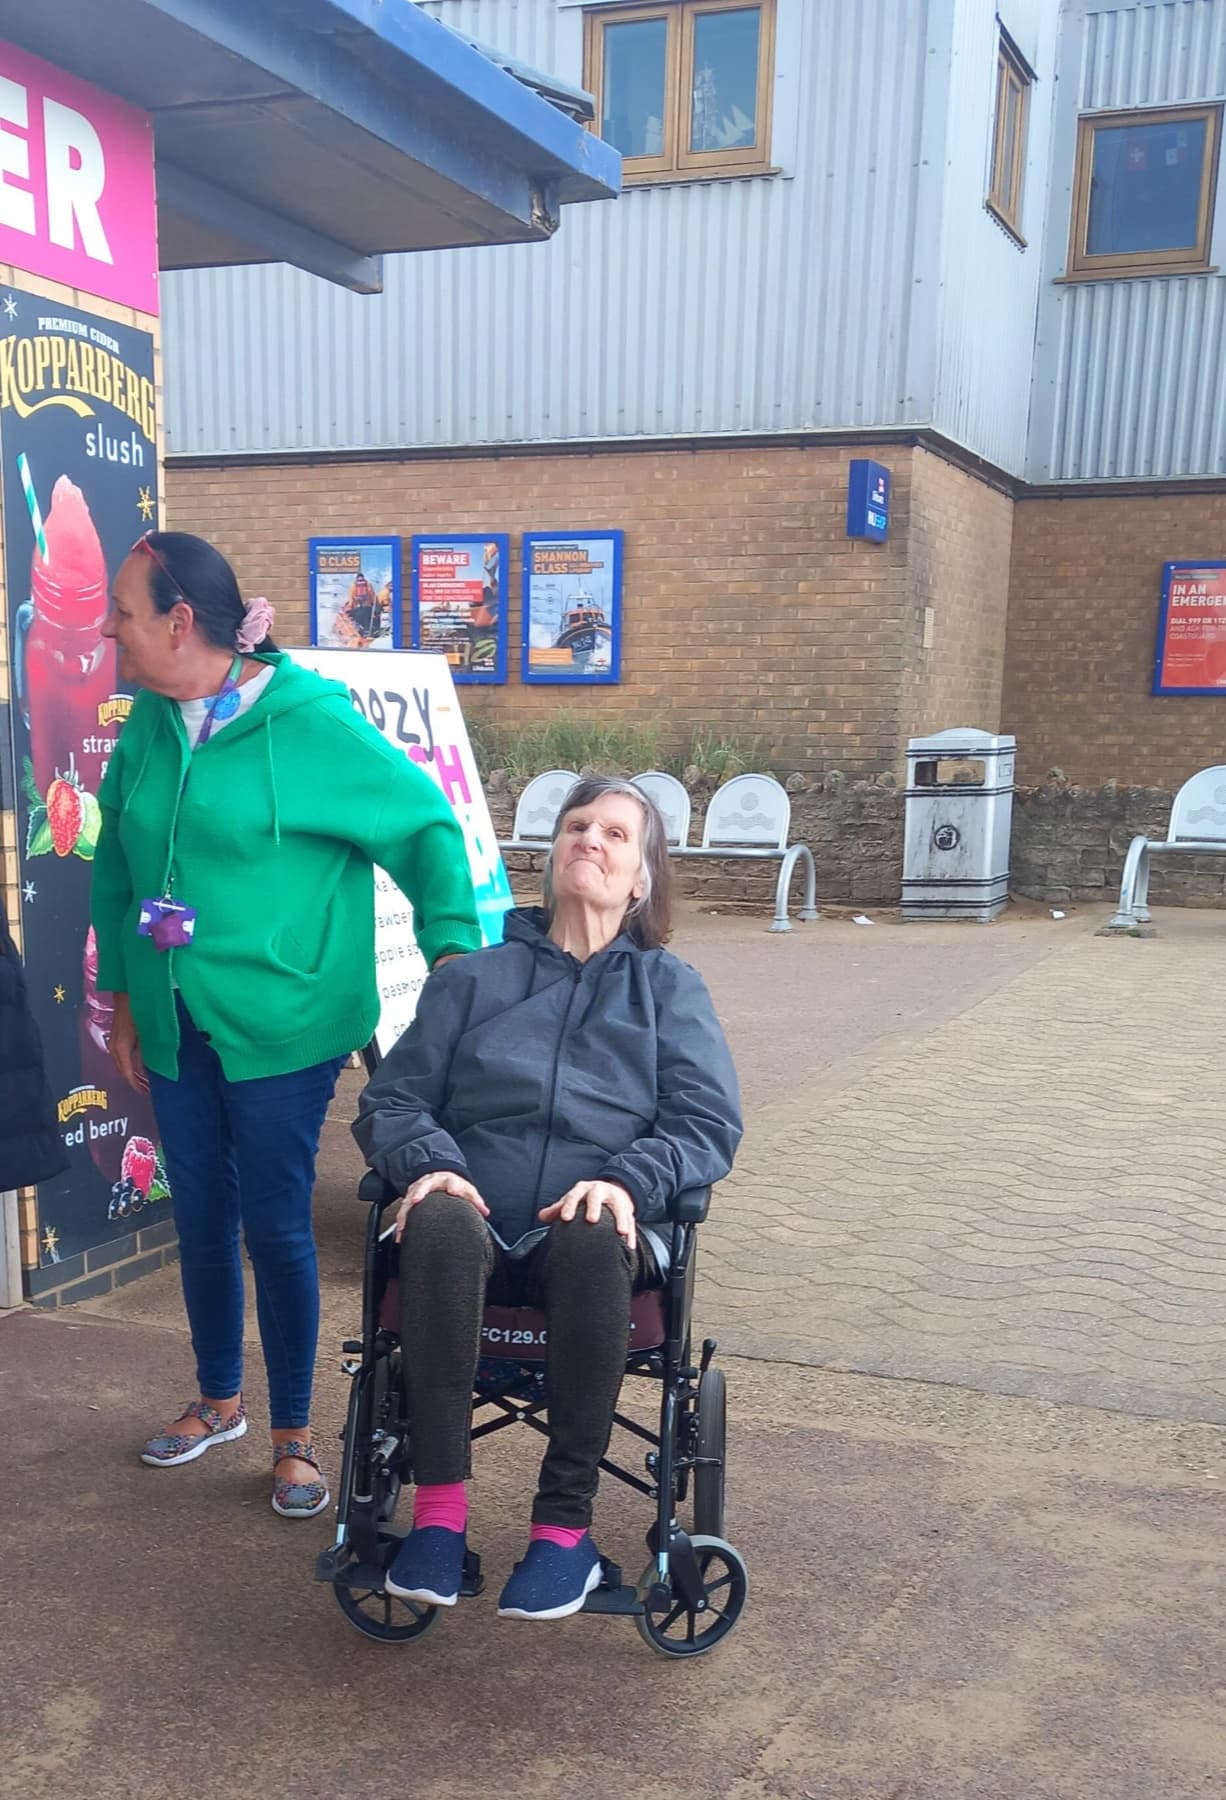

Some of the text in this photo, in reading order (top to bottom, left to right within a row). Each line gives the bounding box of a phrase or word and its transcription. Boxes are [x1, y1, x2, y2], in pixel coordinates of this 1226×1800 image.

[37, 316, 120, 355] PREMIUM CIDER
[0, 334, 156, 444] KOPPARBERG
[85, 422, 144, 468] slush
[329, 555, 360, 567] CLASS
[422, 554, 467, 565] BEWARE
[534, 551, 587, 563] SHANNON
[534, 562, 569, 574] CLASS
[1173, 584, 1207, 595] IN AN
[60, 1117, 128, 1146] ed berry
